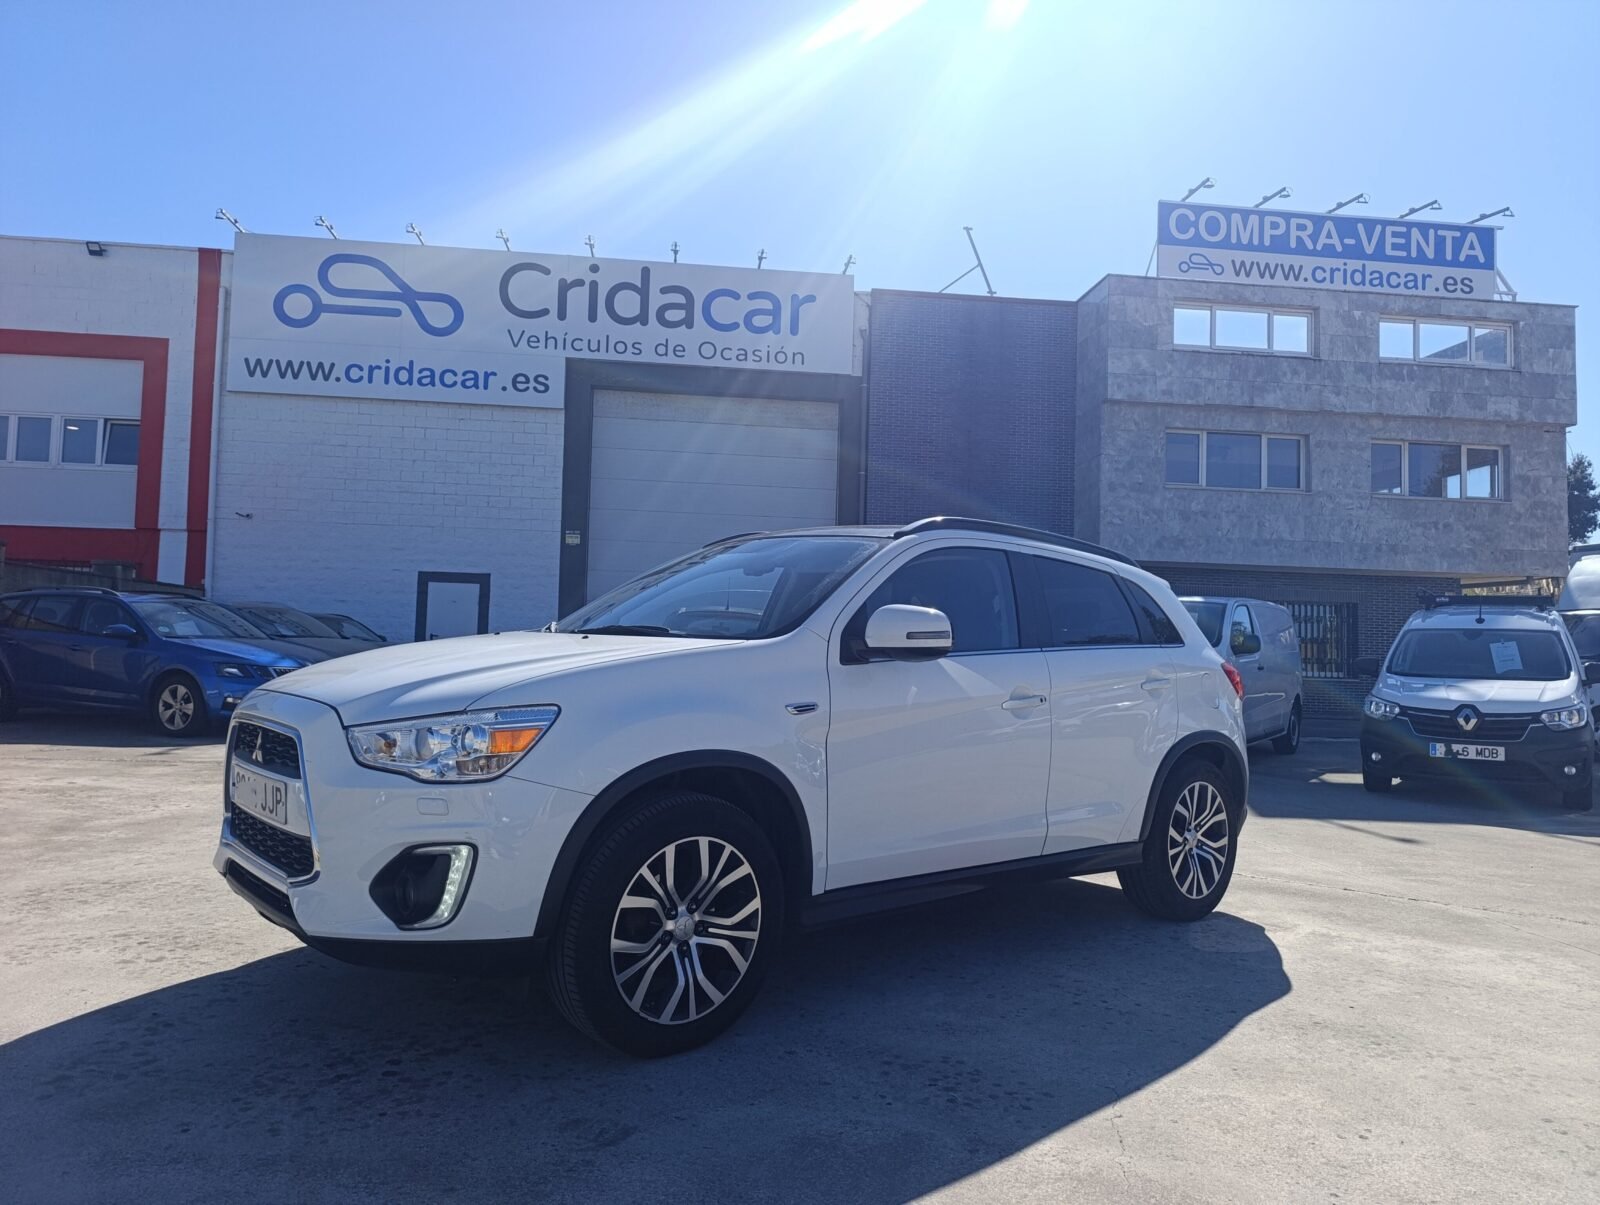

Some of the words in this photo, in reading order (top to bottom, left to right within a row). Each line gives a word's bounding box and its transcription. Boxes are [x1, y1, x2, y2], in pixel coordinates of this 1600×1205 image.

[1168, 207, 1485, 264] COMPRA-VENTA
[1231, 258, 1474, 295] www.cridacar.es
[499, 262, 817, 337] Cridacar
[507, 328, 643, 358] Vehículos
[654, 337, 685, 360] de
[698, 340, 806, 367] Ocasión
[244, 356, 550, 395] www.cridacar.es
[1475, 747, 1499, 759] MDB
[261, 783, 283, 816] JJP
